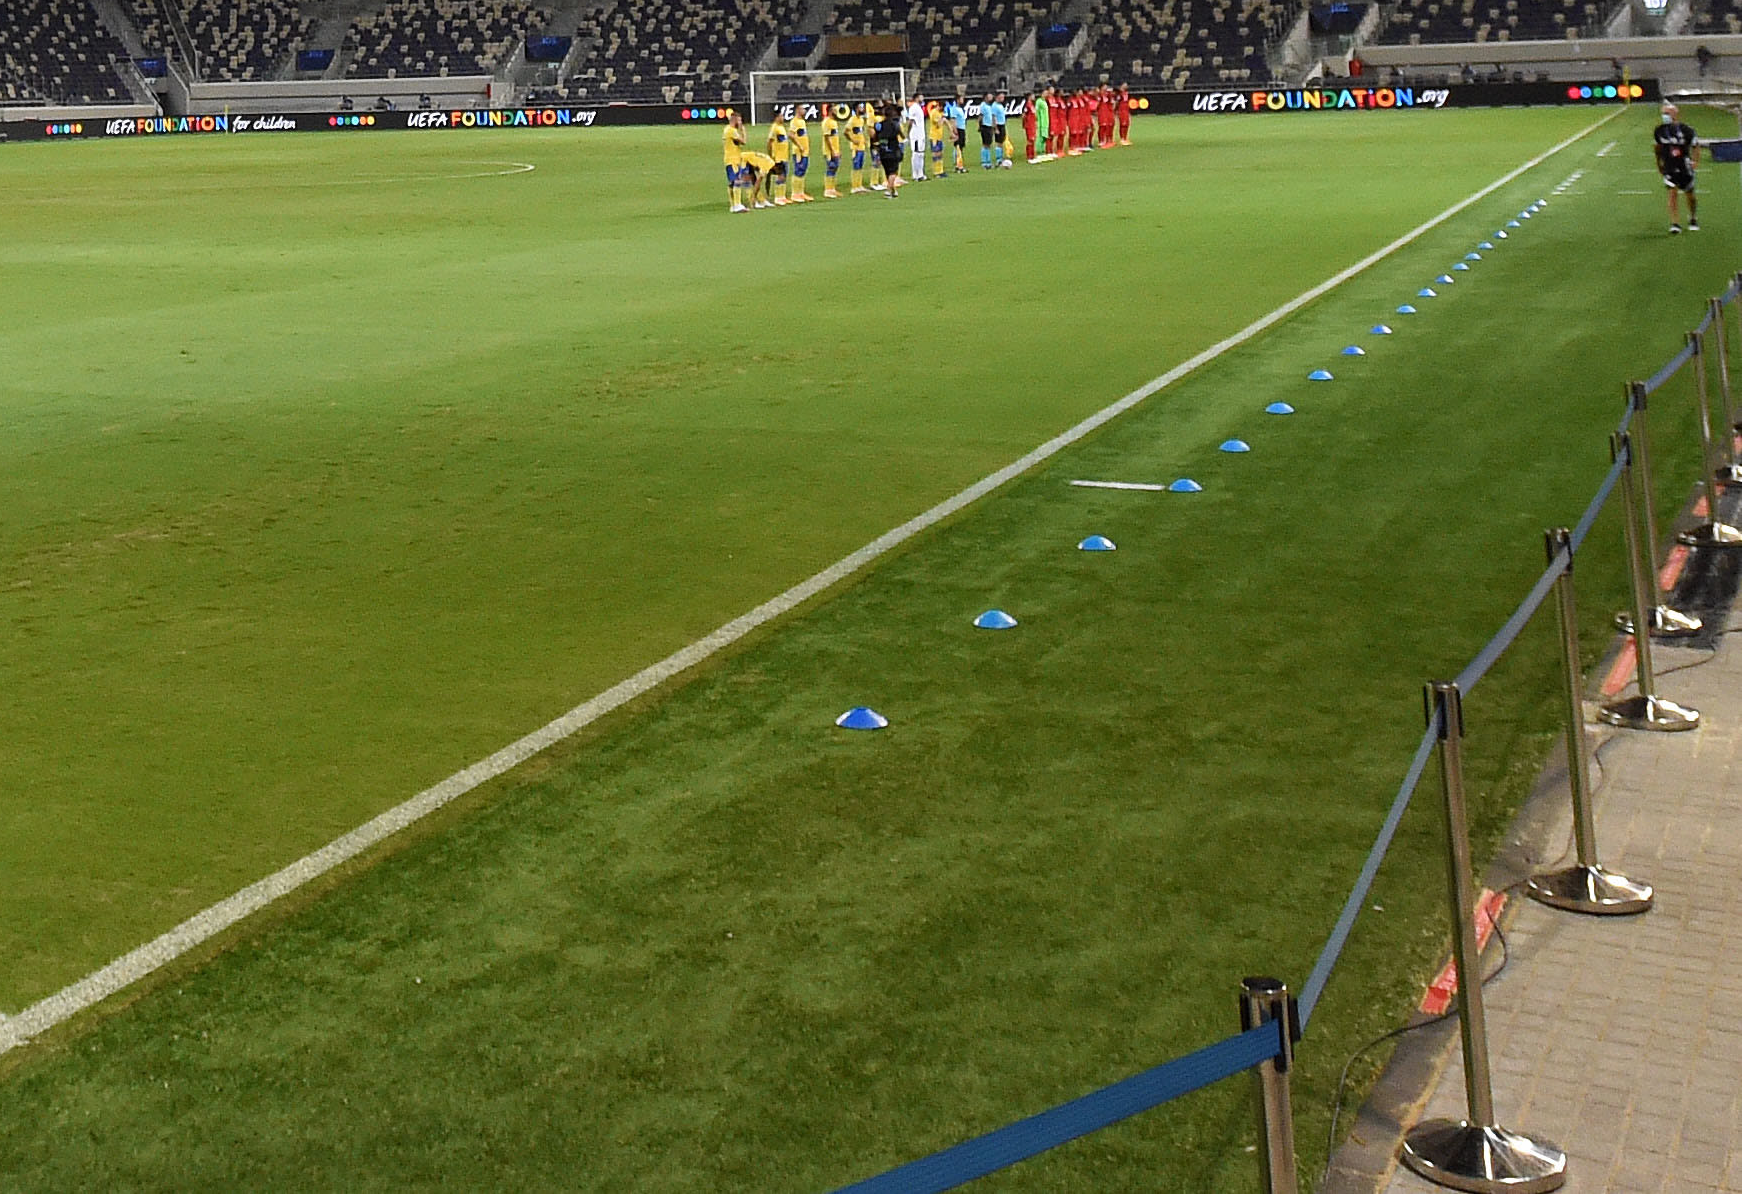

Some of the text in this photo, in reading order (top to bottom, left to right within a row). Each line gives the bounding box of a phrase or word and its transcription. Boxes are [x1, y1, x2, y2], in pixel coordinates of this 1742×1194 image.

[1193, 92, 1249, 111] UEFA
[1417, 89, 1450, 108] .org
[105, 118, 136, 135] UEFA
[232, 115, 251, 133] for
[253, 115, 296, 130] children
[407, 111, 449, 128] UEFA
[572, 110, 597, 126] .org
